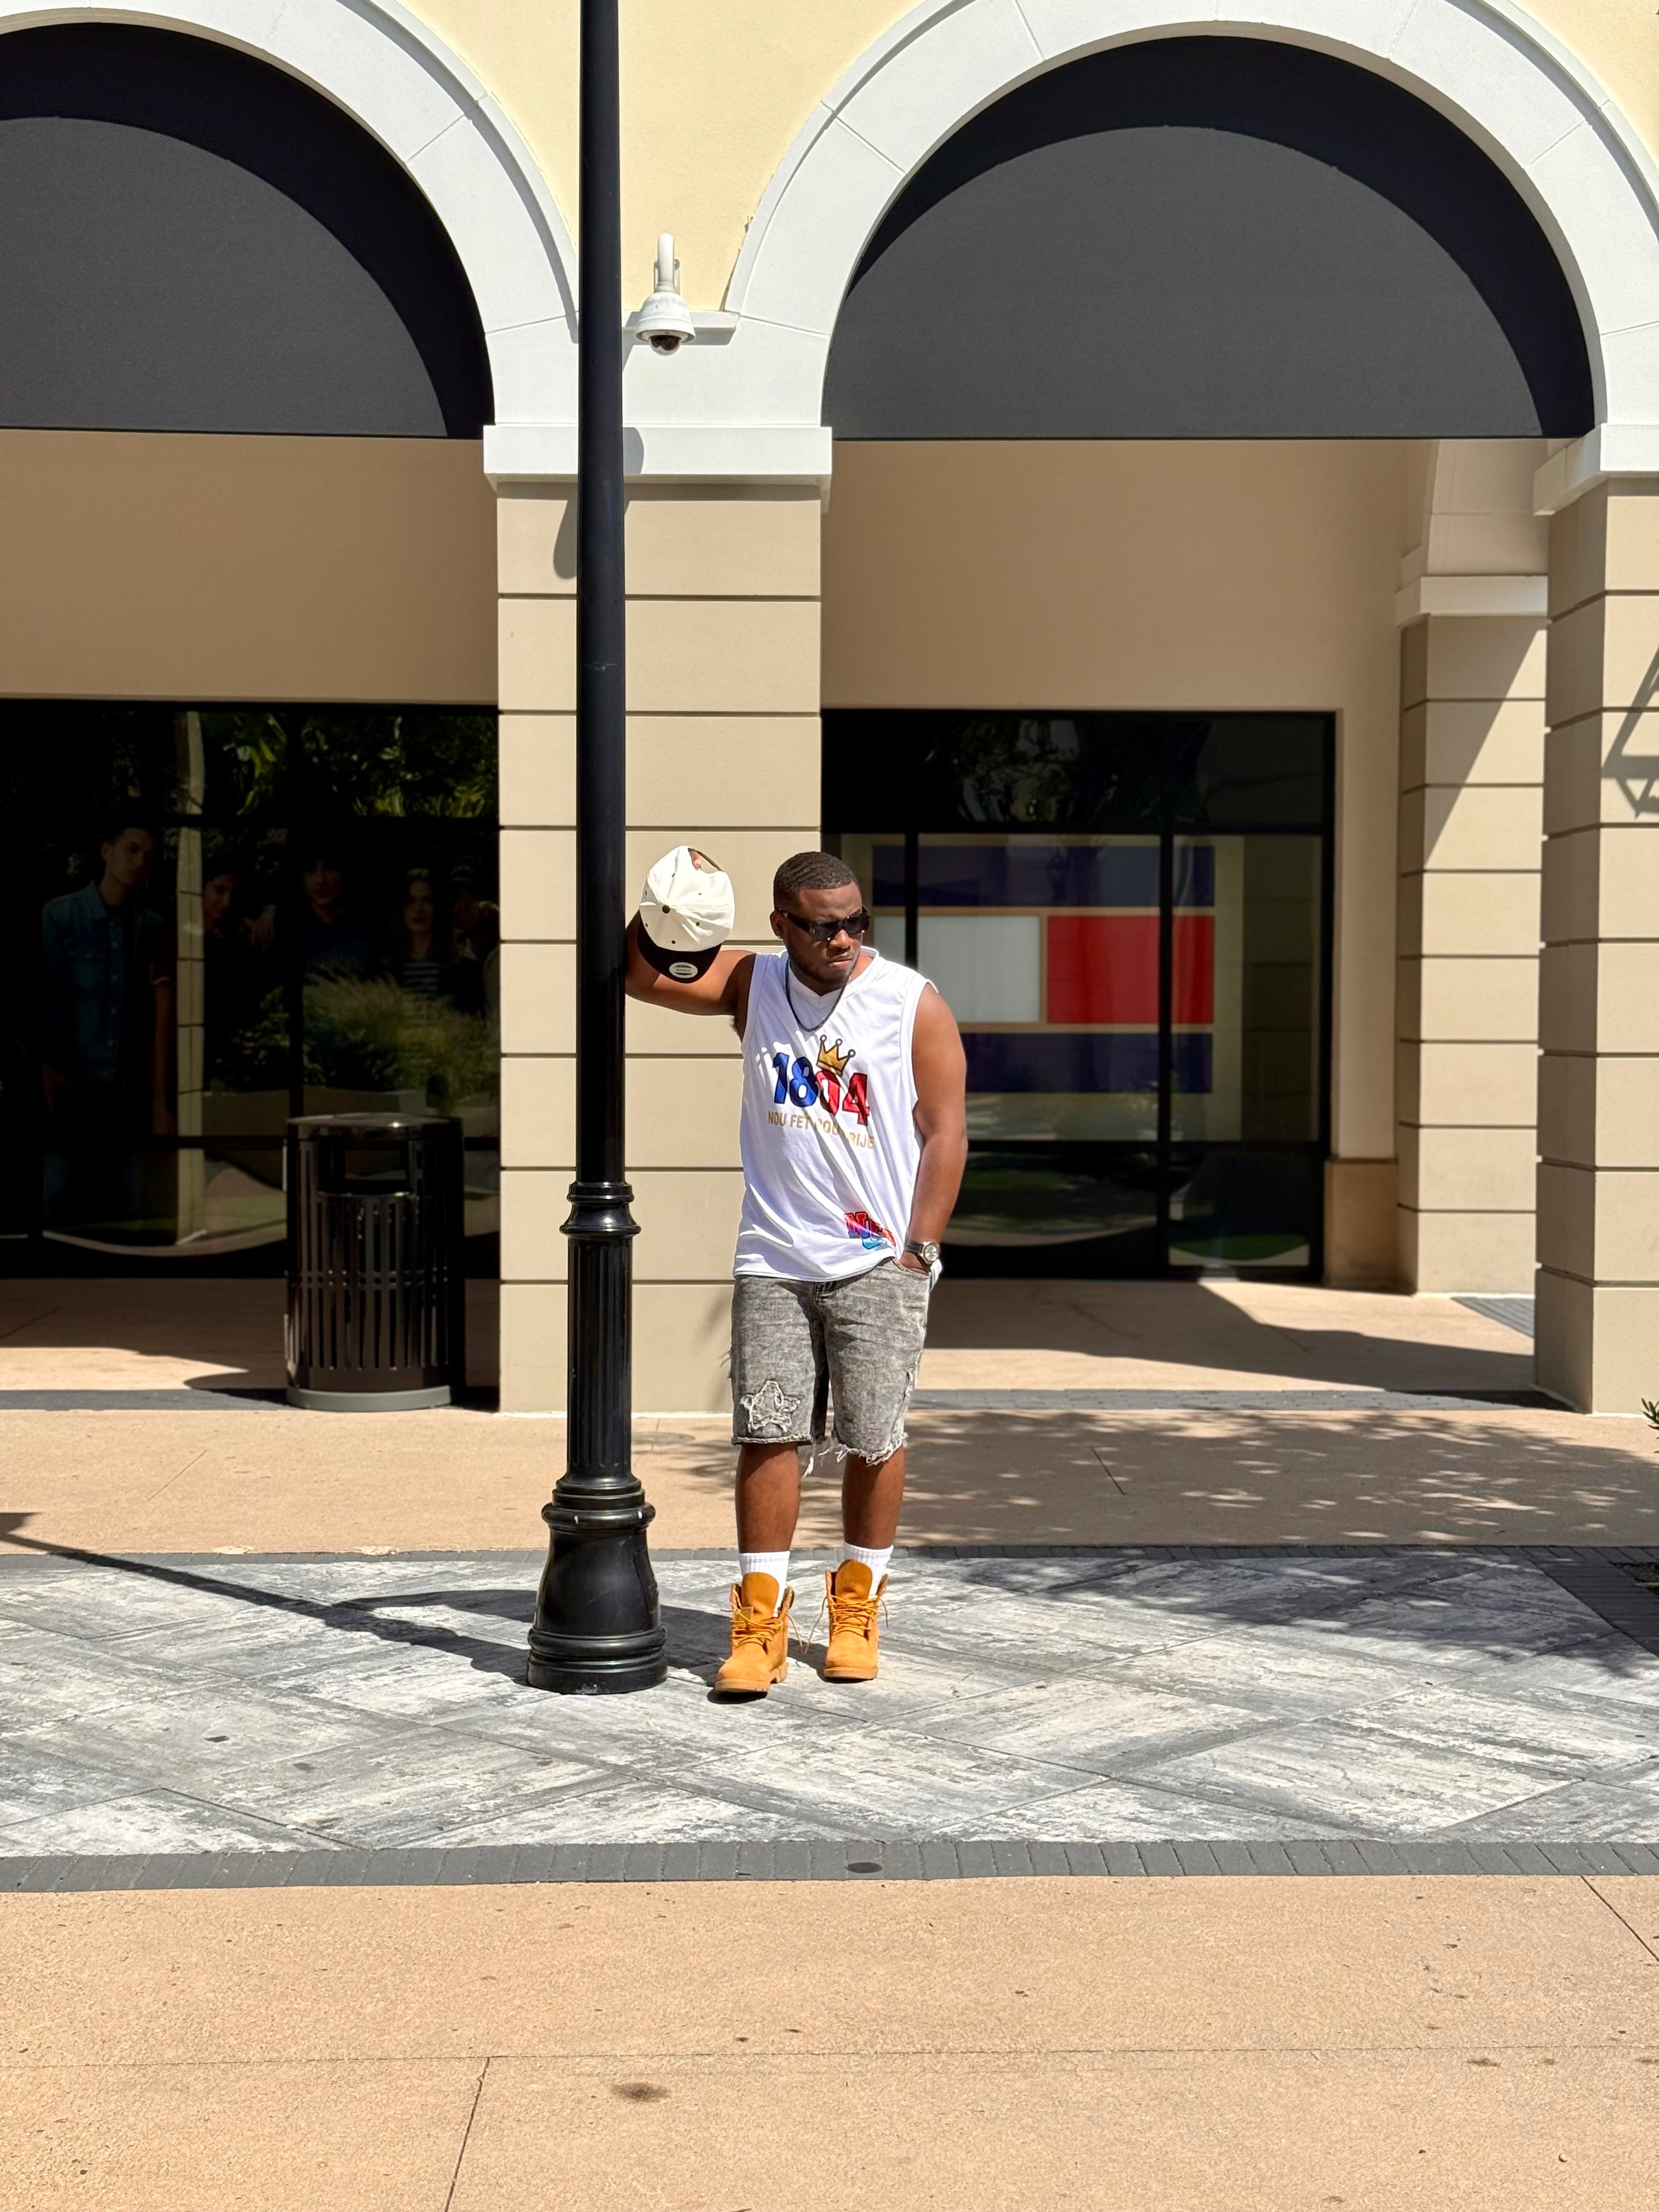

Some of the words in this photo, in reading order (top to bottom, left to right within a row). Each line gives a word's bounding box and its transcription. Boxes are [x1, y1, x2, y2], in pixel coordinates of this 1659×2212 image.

[772, 1052, 870, 1126] 1804
[768, 1110, 787, 1126] NOU
[790, 1114, 811, 1130] FET
